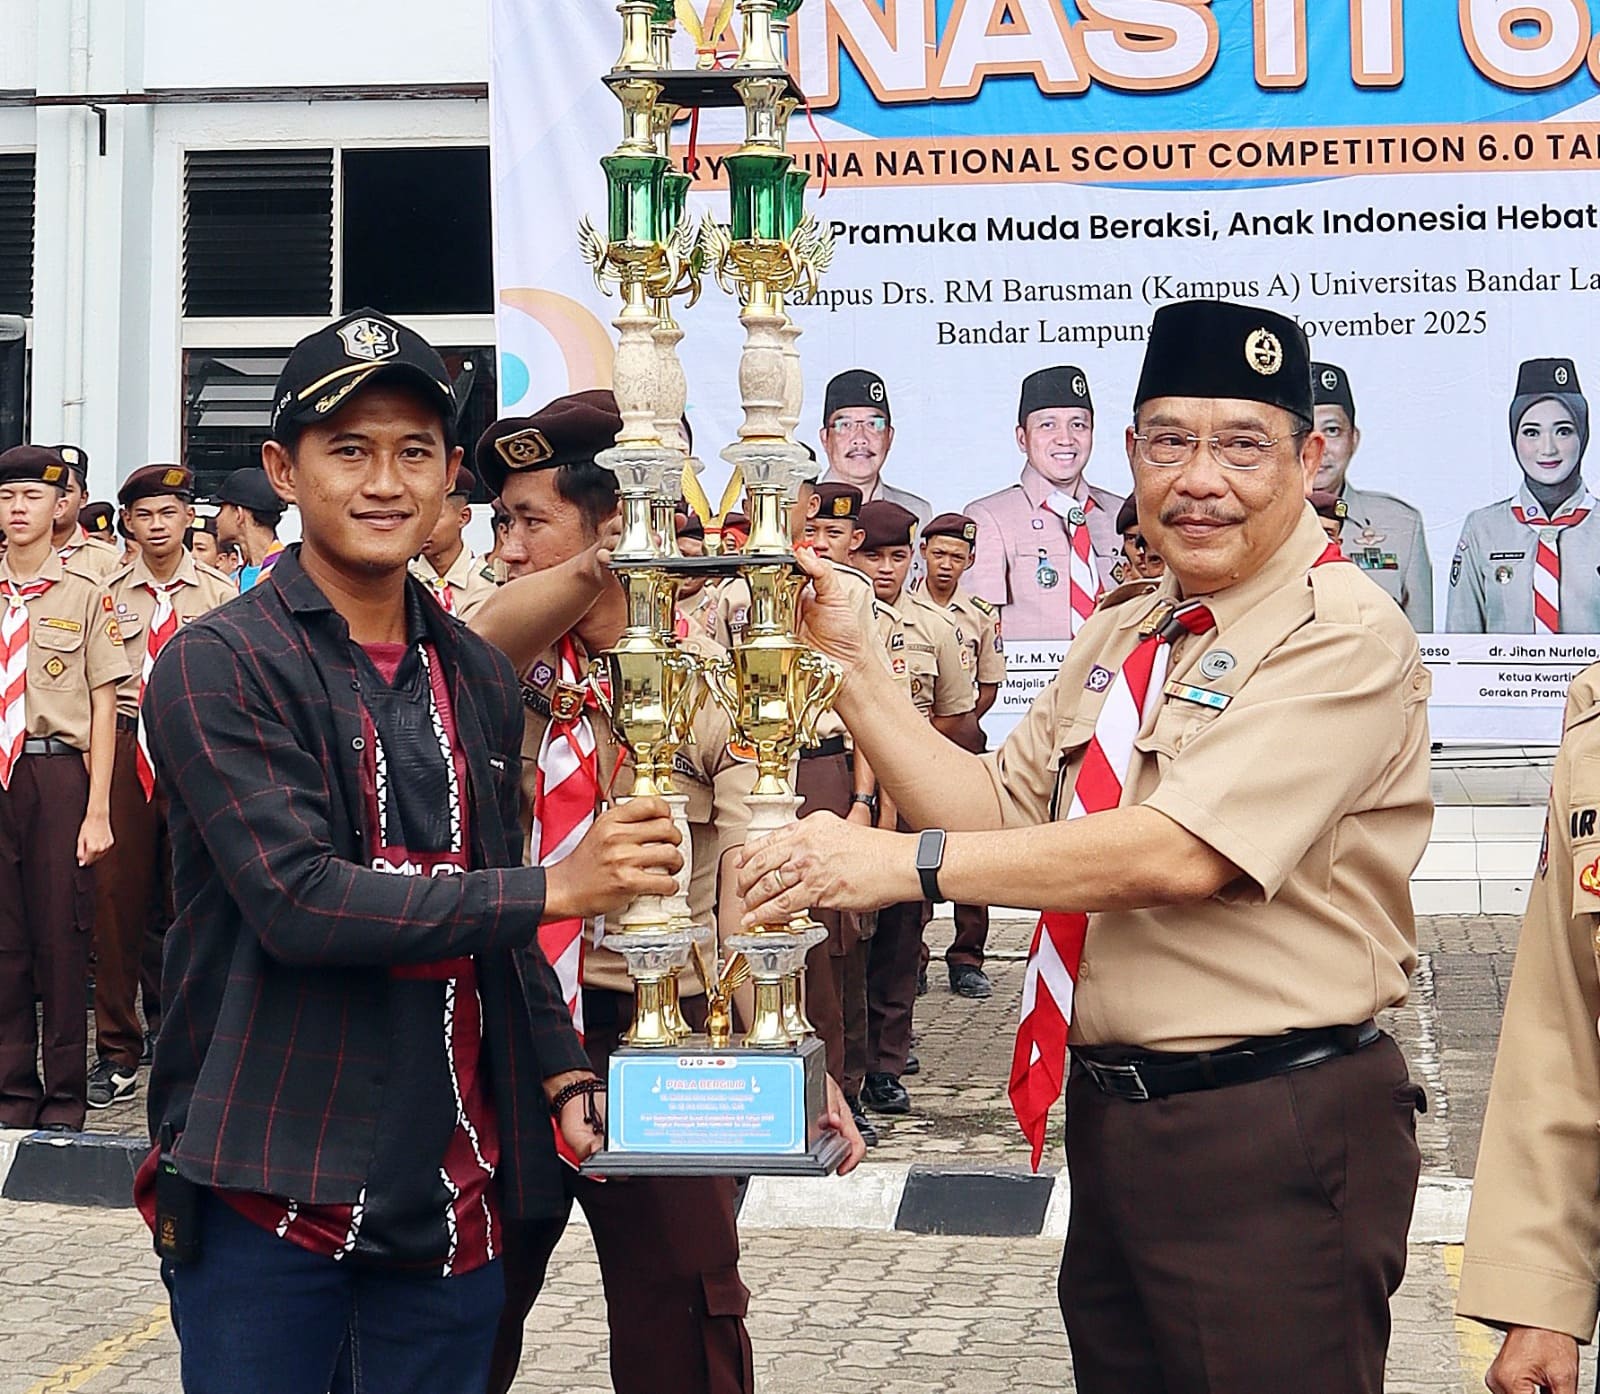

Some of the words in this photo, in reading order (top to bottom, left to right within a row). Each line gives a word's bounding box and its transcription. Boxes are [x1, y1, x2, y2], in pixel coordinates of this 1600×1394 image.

[792, 150, 864, 178] NA
[876, 147, 1060, 177] NATIONAL
[1072, 143, 1197, 172] SCOUT
[1208, 136, 1465, 169] COMPETITION
[1478, 134, 1534, 161] 6.0
[1546, 133, 1600, 160] TA
[832, 217, 977, 245] Pramuka
[987, 215, 1079, 242] Muda
[1090, 210, 1219, 241] Beraksi,
[1228, 209, 1314, 237] Anak
[1323, 204, 1486, 235] Indonesia
[1497, 203, 1598, 231] Hebat
[882, 281, 934, 306] Drs.
[944, 279, 992, 304] RM
[1003, 278, 1132, 302] Barusman
[1141, 272, 1259, 305] (Kampus
[1267, 271, 1300, 302] A)
[1310, 269, 1457, 296] Universitas
[1467, 267, 1561, 292] Bandar
[937, 320, 1030, 345] Bandar
[1297, 312, 1415, 339] ovember
[1424, 310, 1487, 336] 2025
[1030, 653, 1046, 664] M.
[1048, 652, 1065, 663] Yu
[1420, 646, 1450, 657] seso
[1488, 645, 1506, 657] dr.
[1509, 646, 1546, 658] Jihan
[1498, 672, 1532, 682] Ketua
[1479, 687, 1528, 698] Gerakan
[1530, 688, 1568, 698] Pramu
